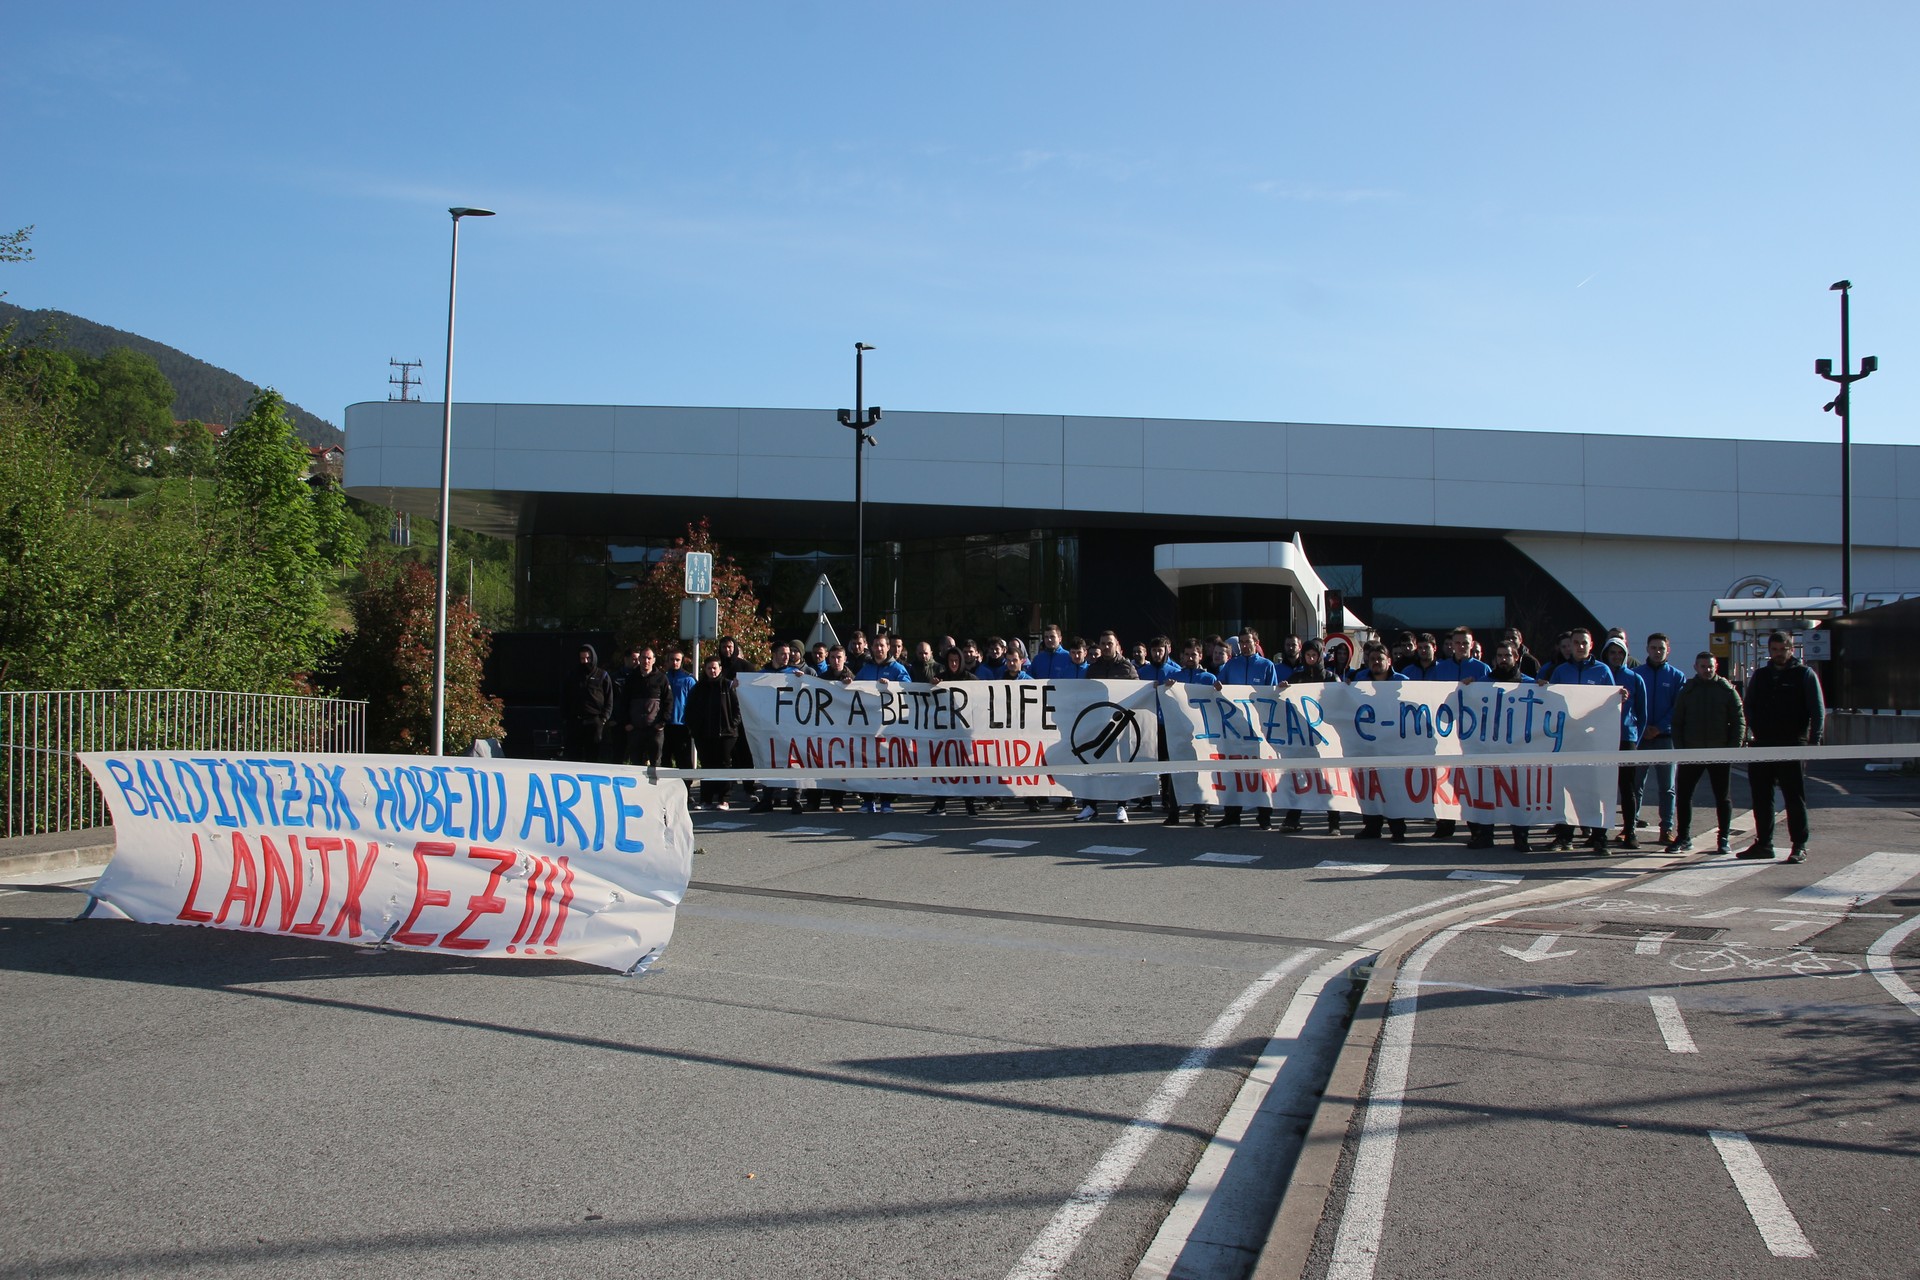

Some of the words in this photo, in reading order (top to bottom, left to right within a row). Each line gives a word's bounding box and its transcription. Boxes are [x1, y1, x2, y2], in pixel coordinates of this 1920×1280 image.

[774, 686, 835, 726] FOR
[848, 689, 869, 726] A
[880, 687, 971, 730] BETTER
[988, 685, 1057, 731] LIFE
[1189, 695, 1329, 747] IRIZAR
[1354, 687, 1566, 753] e-mobility
[928, 739, 1056, 786] KONTURA
[105, 757, 360, 831] BALDINTZAK
[365, 765, 508, 842] HOBETU
[520, 773, 645, 853] ARTE
[176, 831, 379, 938] LANIK
[392, 842, 578, 955] EZ!!!
